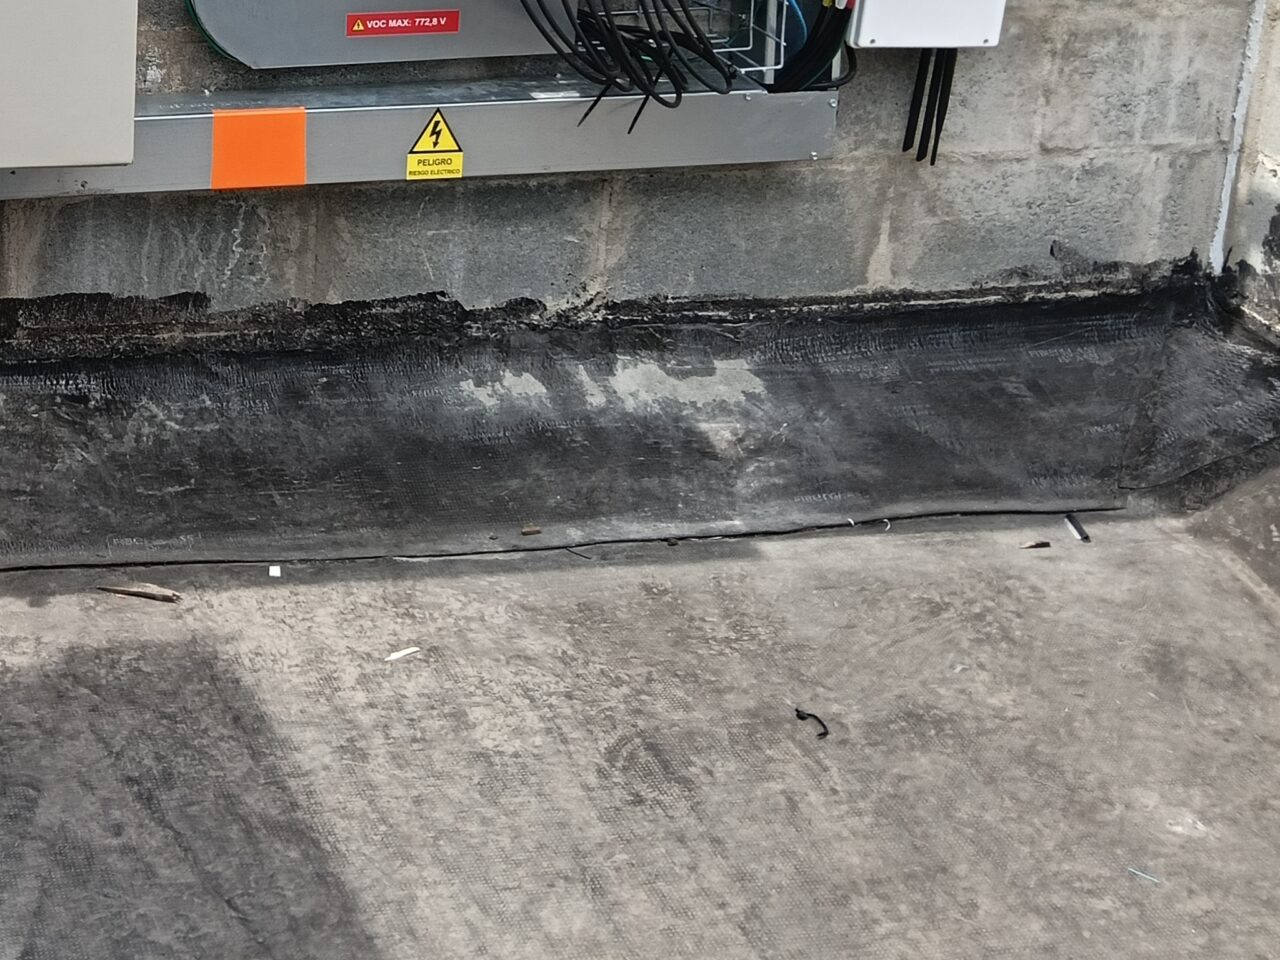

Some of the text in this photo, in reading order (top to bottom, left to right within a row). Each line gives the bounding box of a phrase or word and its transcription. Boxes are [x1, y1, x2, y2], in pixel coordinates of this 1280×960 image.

[366, 17, 447, 29] VOC MAX: 772,8 V
[417, 157, 453, 166] PELIGRO
